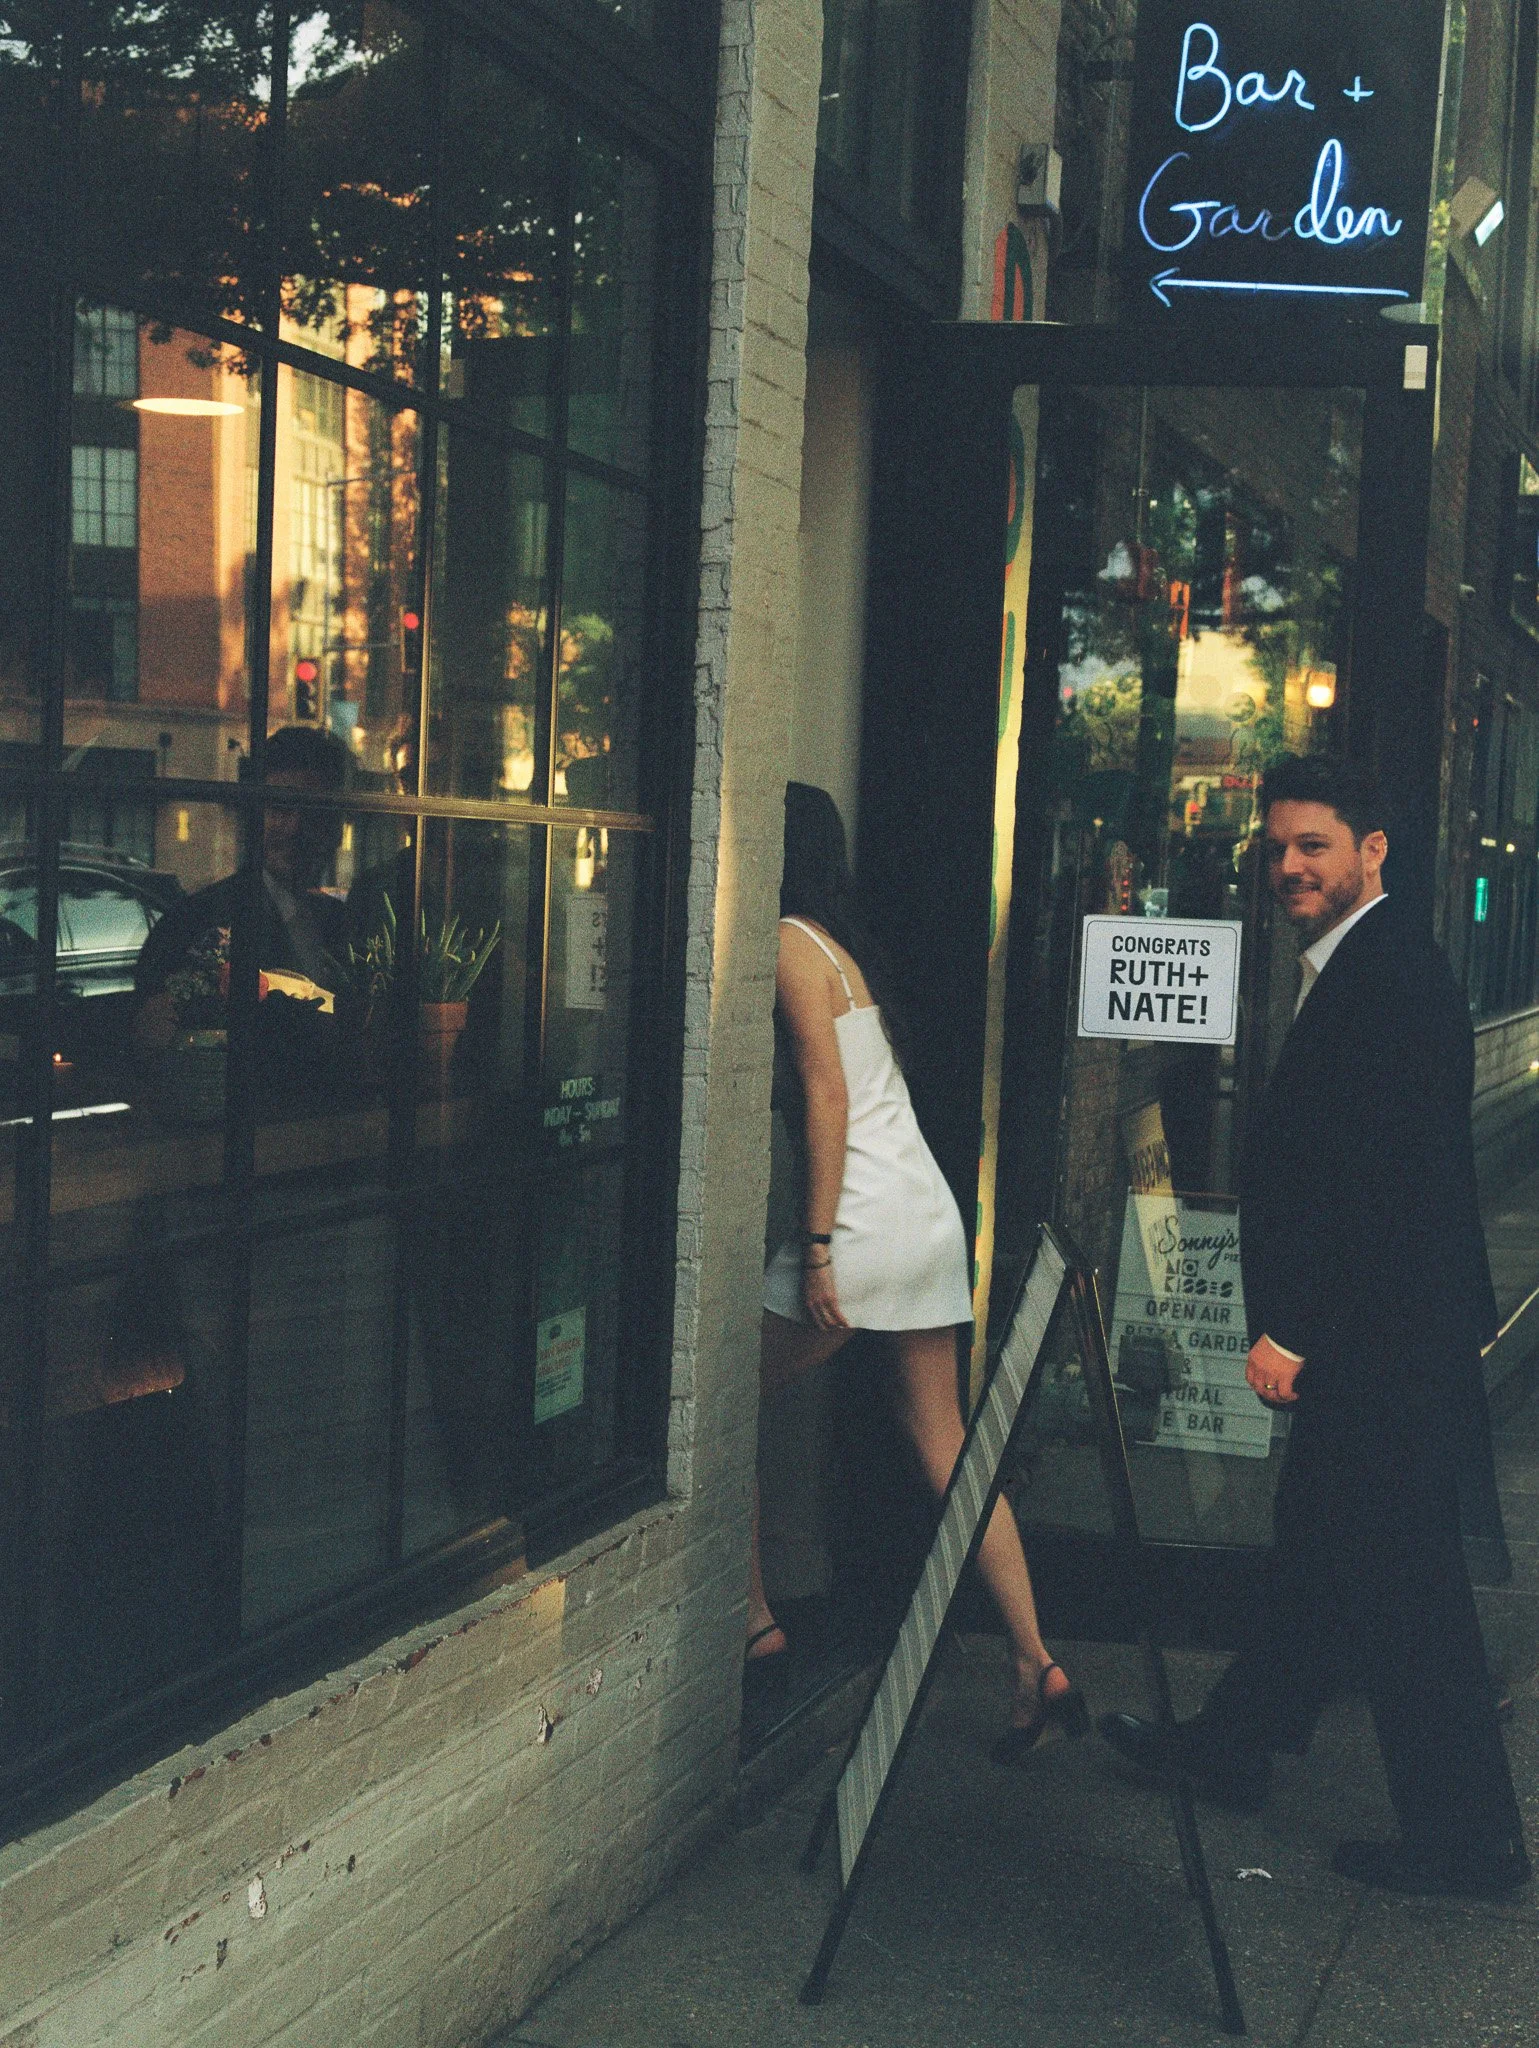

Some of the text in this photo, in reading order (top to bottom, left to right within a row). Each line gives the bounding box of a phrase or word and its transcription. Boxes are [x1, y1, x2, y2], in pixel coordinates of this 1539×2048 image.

[1174, 22, 1375, 132] Bar +
[1138, 138, 1403, 252] Garden
[1111, 935, 1211, 957] CONGRATS
[1107, 990, 1208, 1025] NATE!
[1157, 1214, 1240, 1271] Sonny's
[1165, 1258, 1199, 1277] NO
[1164, 1276, 1234, 1298] KISSES
[1145, 1300, 1232, 1325] OPEN AIR
[1188, 1331, 1250, 1354] GARDE
[1186, 1413, 1225, 1434] BAR
